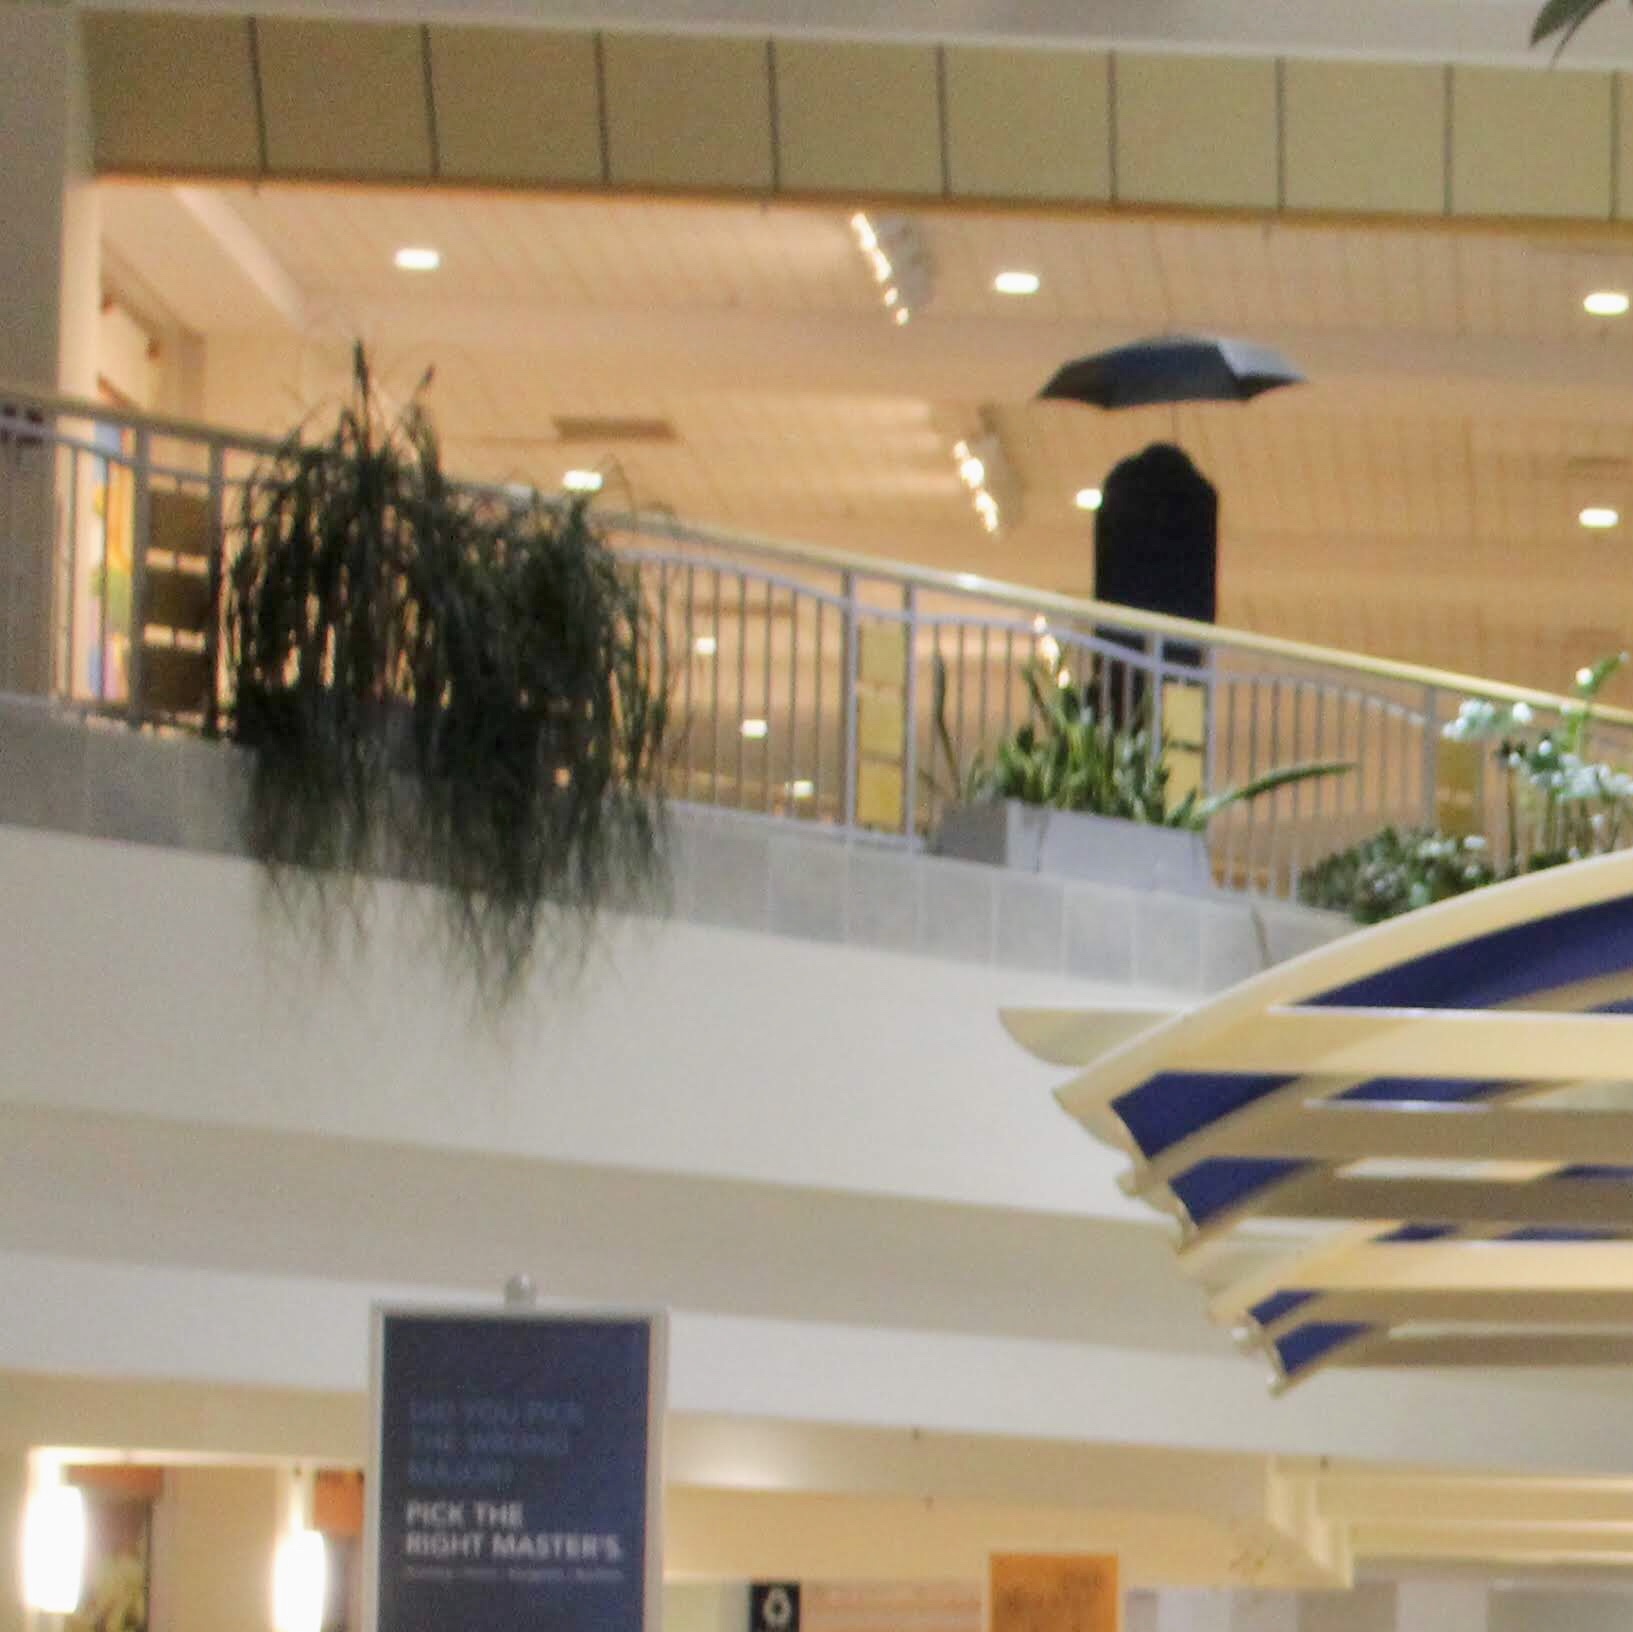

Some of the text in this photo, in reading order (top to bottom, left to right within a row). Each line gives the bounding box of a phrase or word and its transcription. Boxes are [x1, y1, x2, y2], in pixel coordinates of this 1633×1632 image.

[406, 1501, 524, 1528] PICK THE
[406, 1532, 486, 1559] RIGHT
